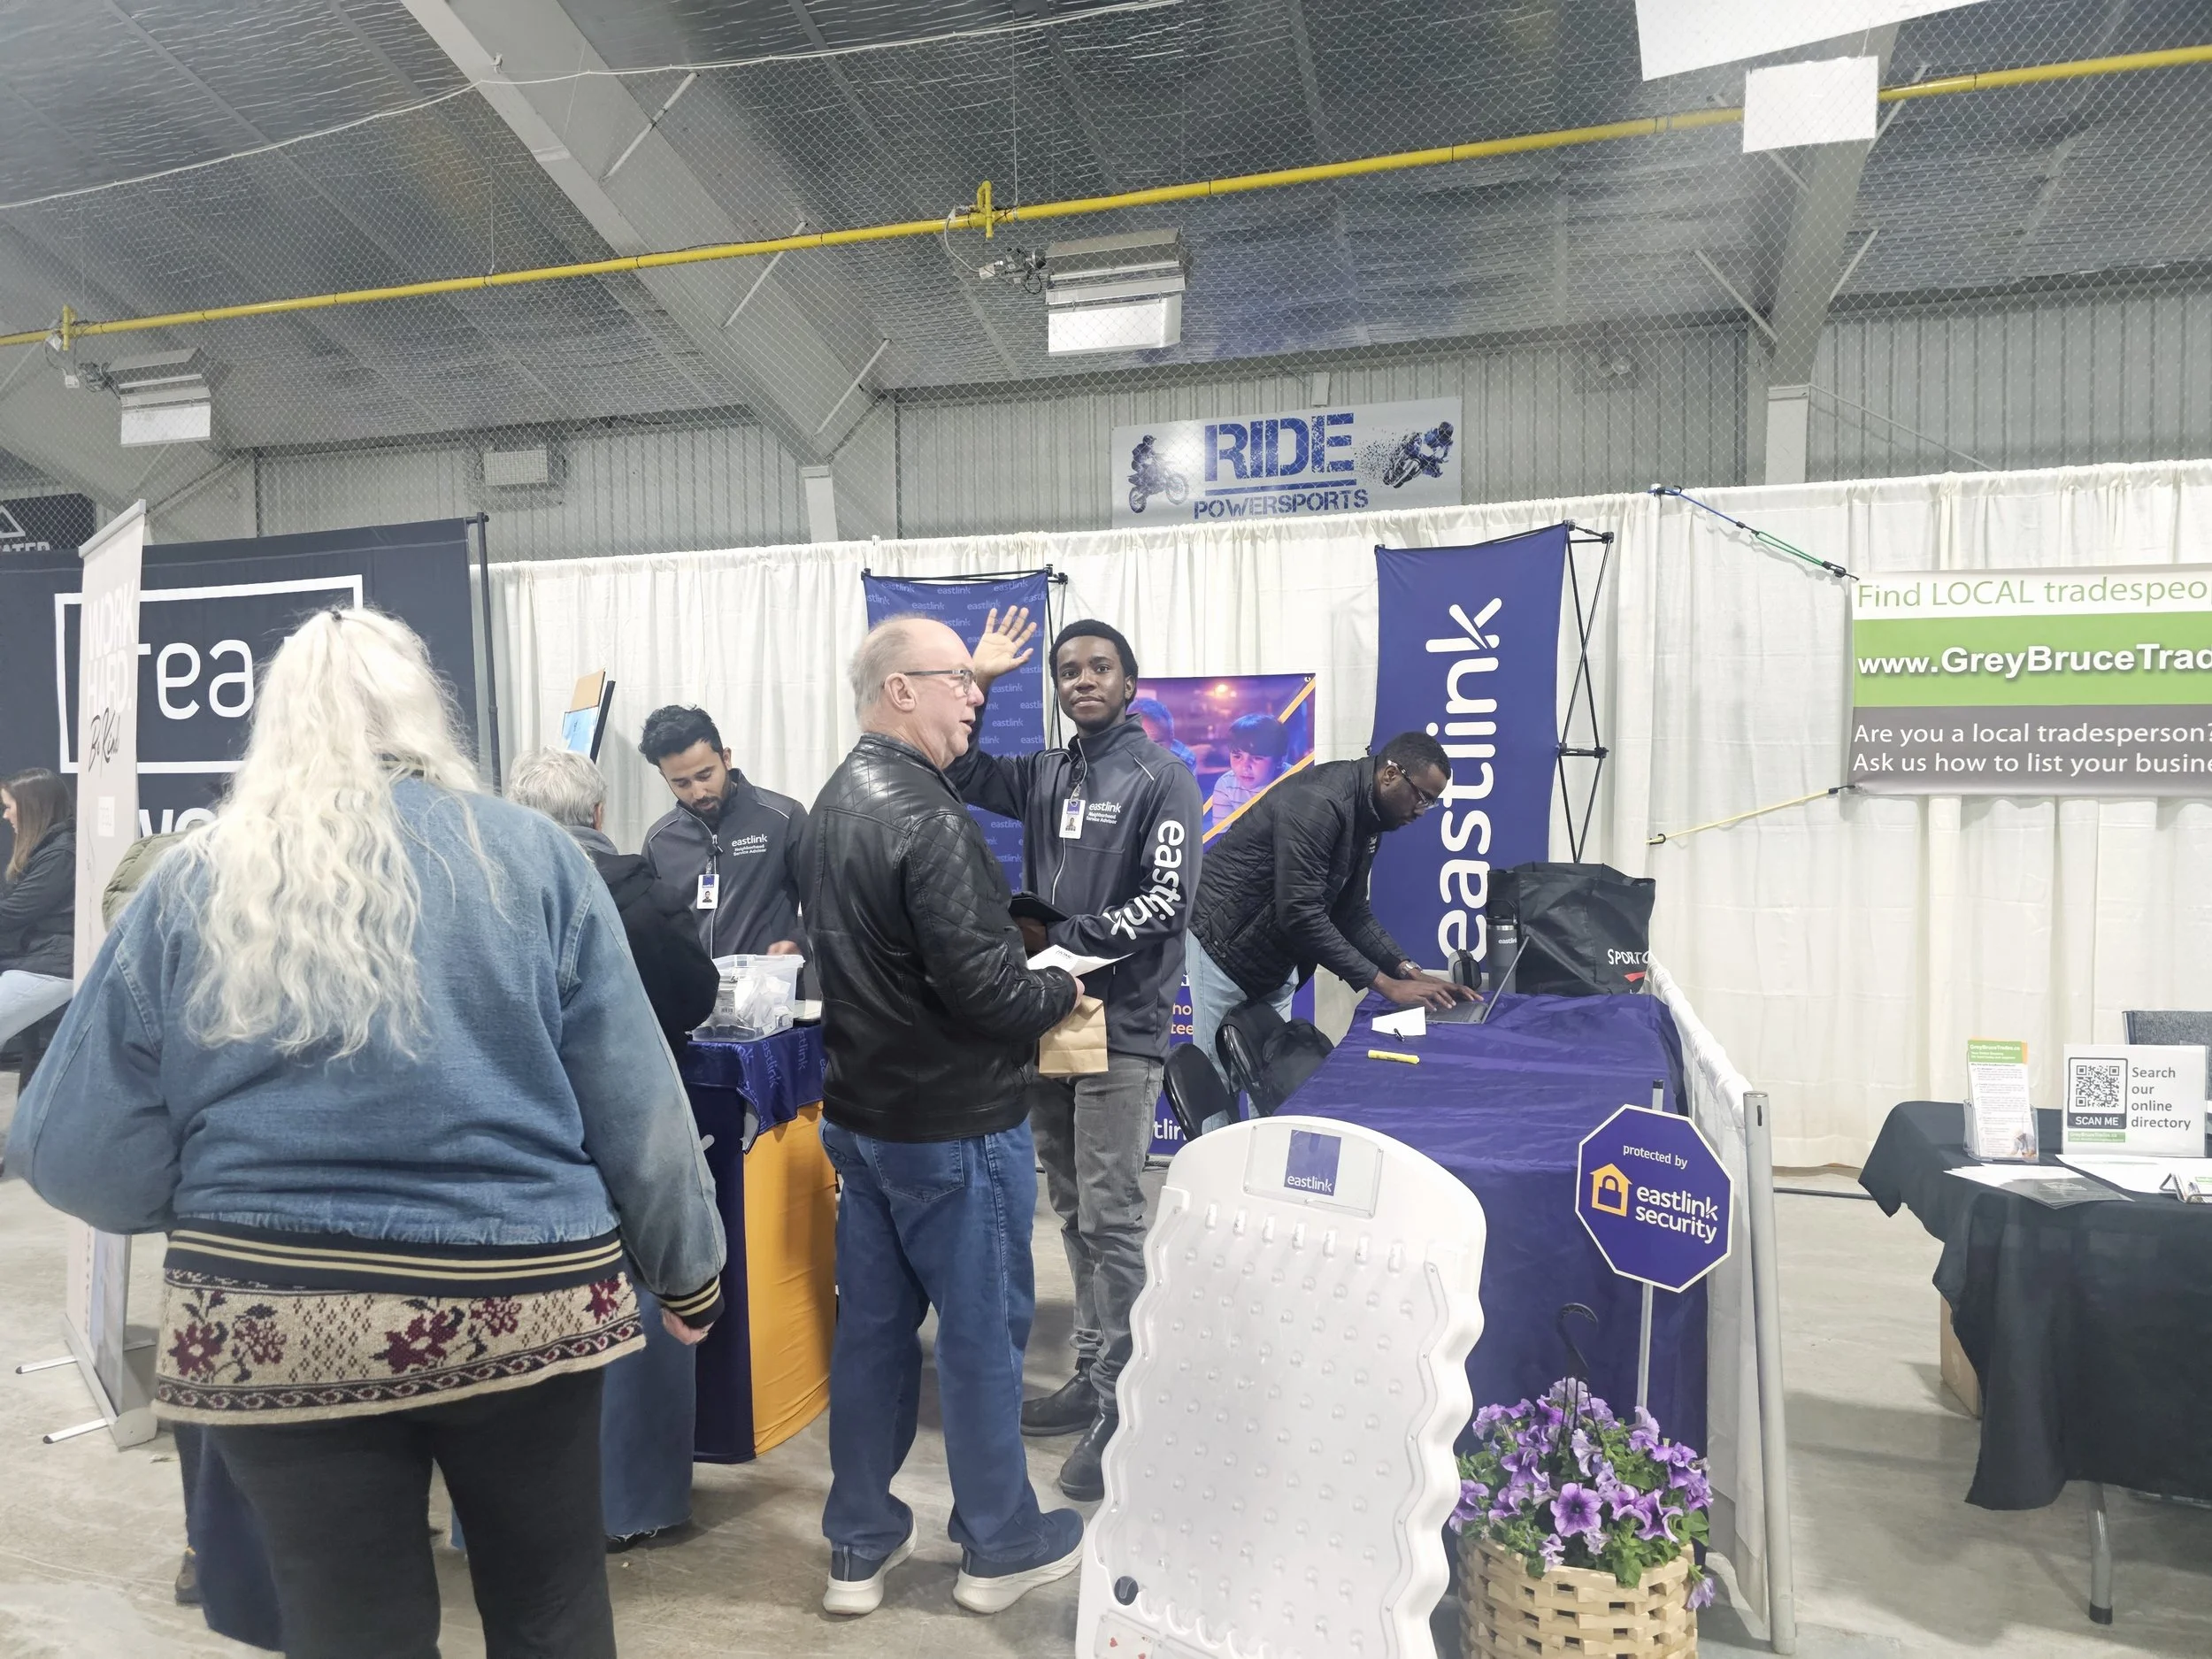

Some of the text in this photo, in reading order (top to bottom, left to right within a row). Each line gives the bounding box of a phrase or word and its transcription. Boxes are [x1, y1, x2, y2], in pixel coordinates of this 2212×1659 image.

[1204, 412, 1355, 481] RIDE
[1194, 488, 1369, 520] POWERSPORTS
[880, 581, 915, 593] eastlink
[937, 586, 972, 595] eastlink
[994, 579, 1028, 592] eastlink
[1858, 576, 2212, 608] Find LOCAL tradespeo
[911, 601, 945, 610] eastlink
[967, 598, 1002, 611] eastlink
[88, 579, 135, 662] WORK
[991, 683, 1023, 693] eastlink
[992, 718, 1024, 727] eastlink
[1855, 724, 1893, 743] Are
[1900, 728, 1944, 748] you
[1951, 728, 1964, 743] a
[1973, 722, 2030, 743] local
[1853, 753, 1894, 772] Ask
[1901, 757, 1927, 772] us
[1935, 752, 1986, 772] how
[1993, 755, 2019, 772] to
[2028, 753, 2063, 772] list
[2070, 757, 2129, 777] your
[1425, 596, 1503, 966] eastlink
[1088, 801, 1122, 814] eastlink
[990, 819, 1023, 829] eastlink
[731, 833, 768, 847] eastlink
[1102, 819, 1186, 941] eastlink
[2131, 1066, 2177, 1079] Search
[2131, 1085, 2155, 1095] our
[2131, 1100, 2173, 1112] online
[2075, 1116, 2119, 1126] SCAN ME
[2131, 1116, 2192, 1131] directory
[1623, 1144, 1688, 1170] protected by
[1287, 1174, 1333, 1193] eastlink
[1636, 1186, 1718, 1222] eastlink
[1635, 1205, 1717, 1245] security
